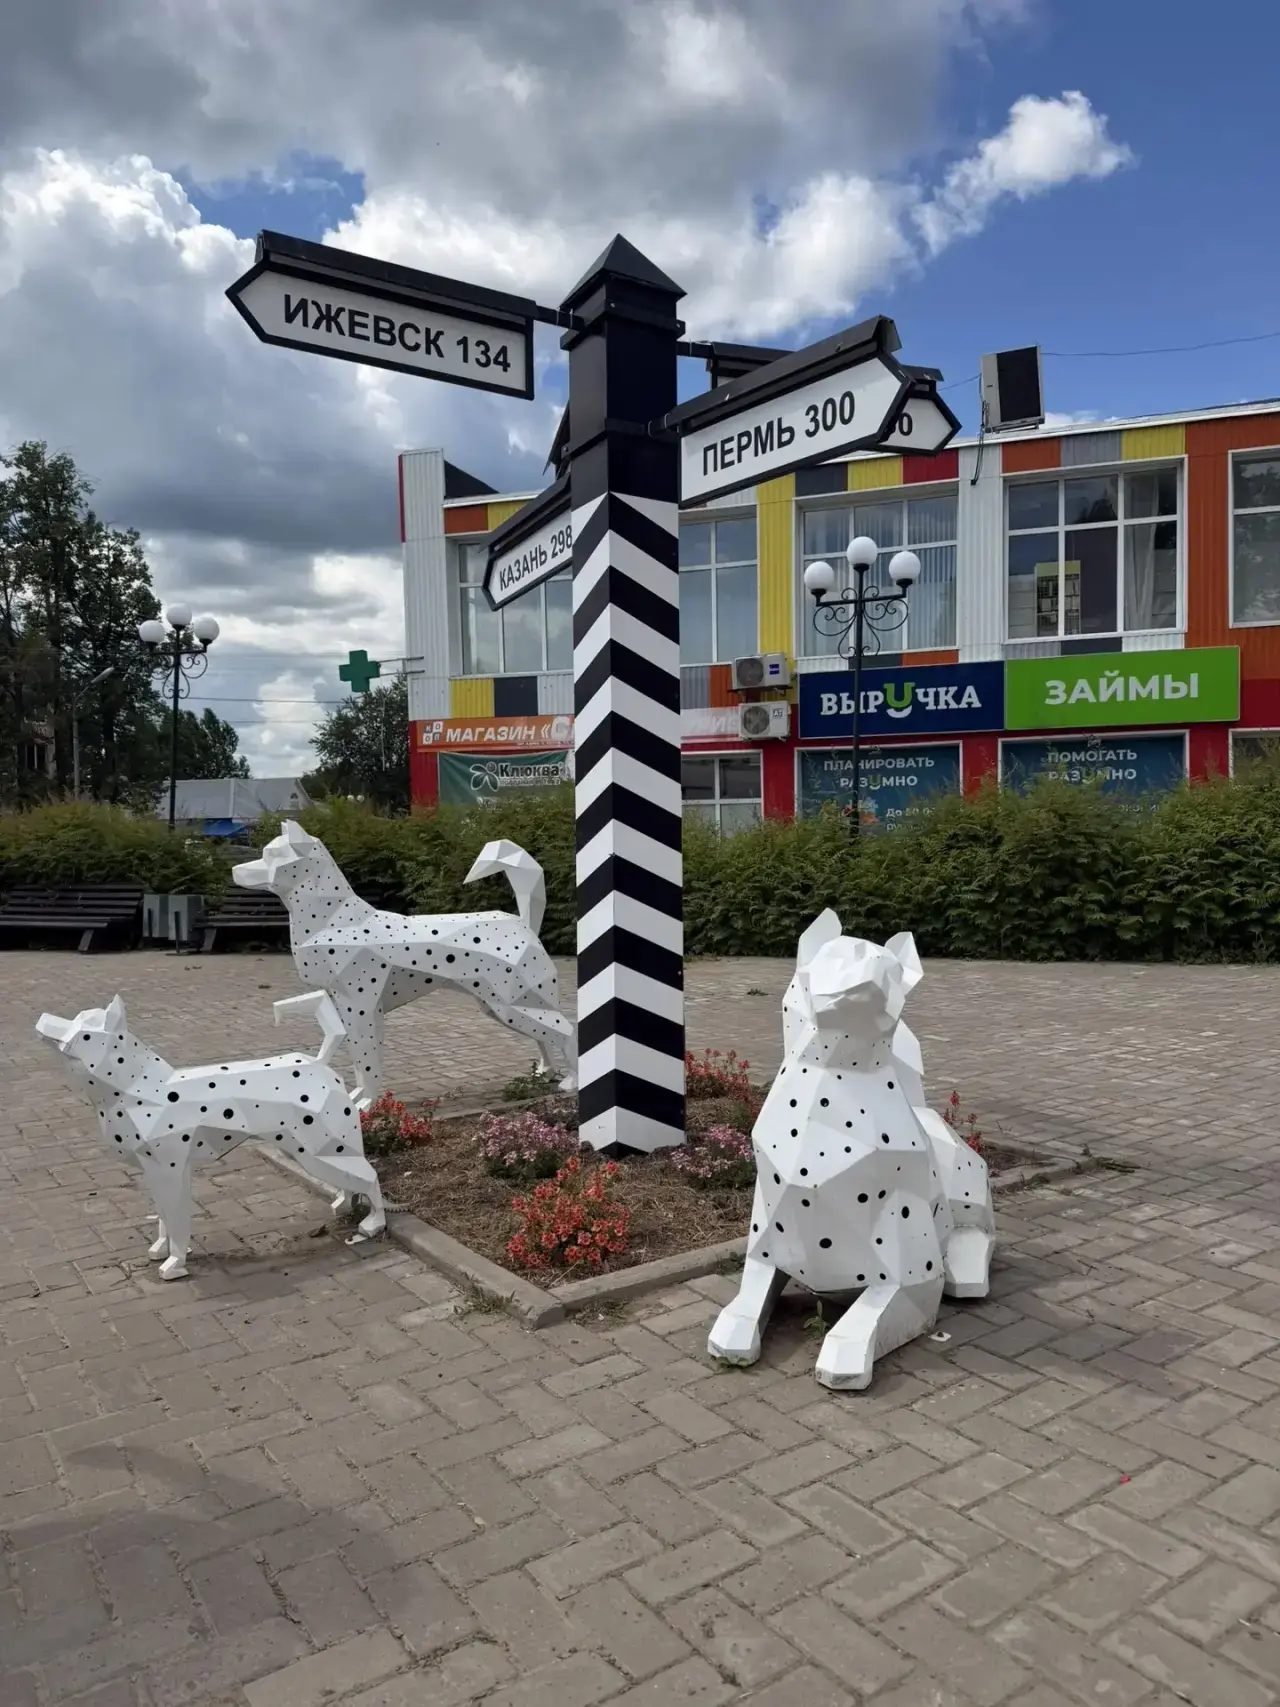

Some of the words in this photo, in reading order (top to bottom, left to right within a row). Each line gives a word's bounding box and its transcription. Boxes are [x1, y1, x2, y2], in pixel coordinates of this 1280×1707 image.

[284, 293, 445, 359] ИЖЕВСК
[456, 335, 511, 373] 134
[703, 417, 796, 477] ПЕРМЬ
[804, 390, 856, 438] 300
[499, 543, 548, 592] КАЗАНЬ
[550, 524, 573, 560] 298
[1044, 670, 1200, 706] ЗАЙМЫ
[446, 725, 536, 743] МАГАЗИН
[1047, 749, 1138, 763] ПОМОГАТЬ
